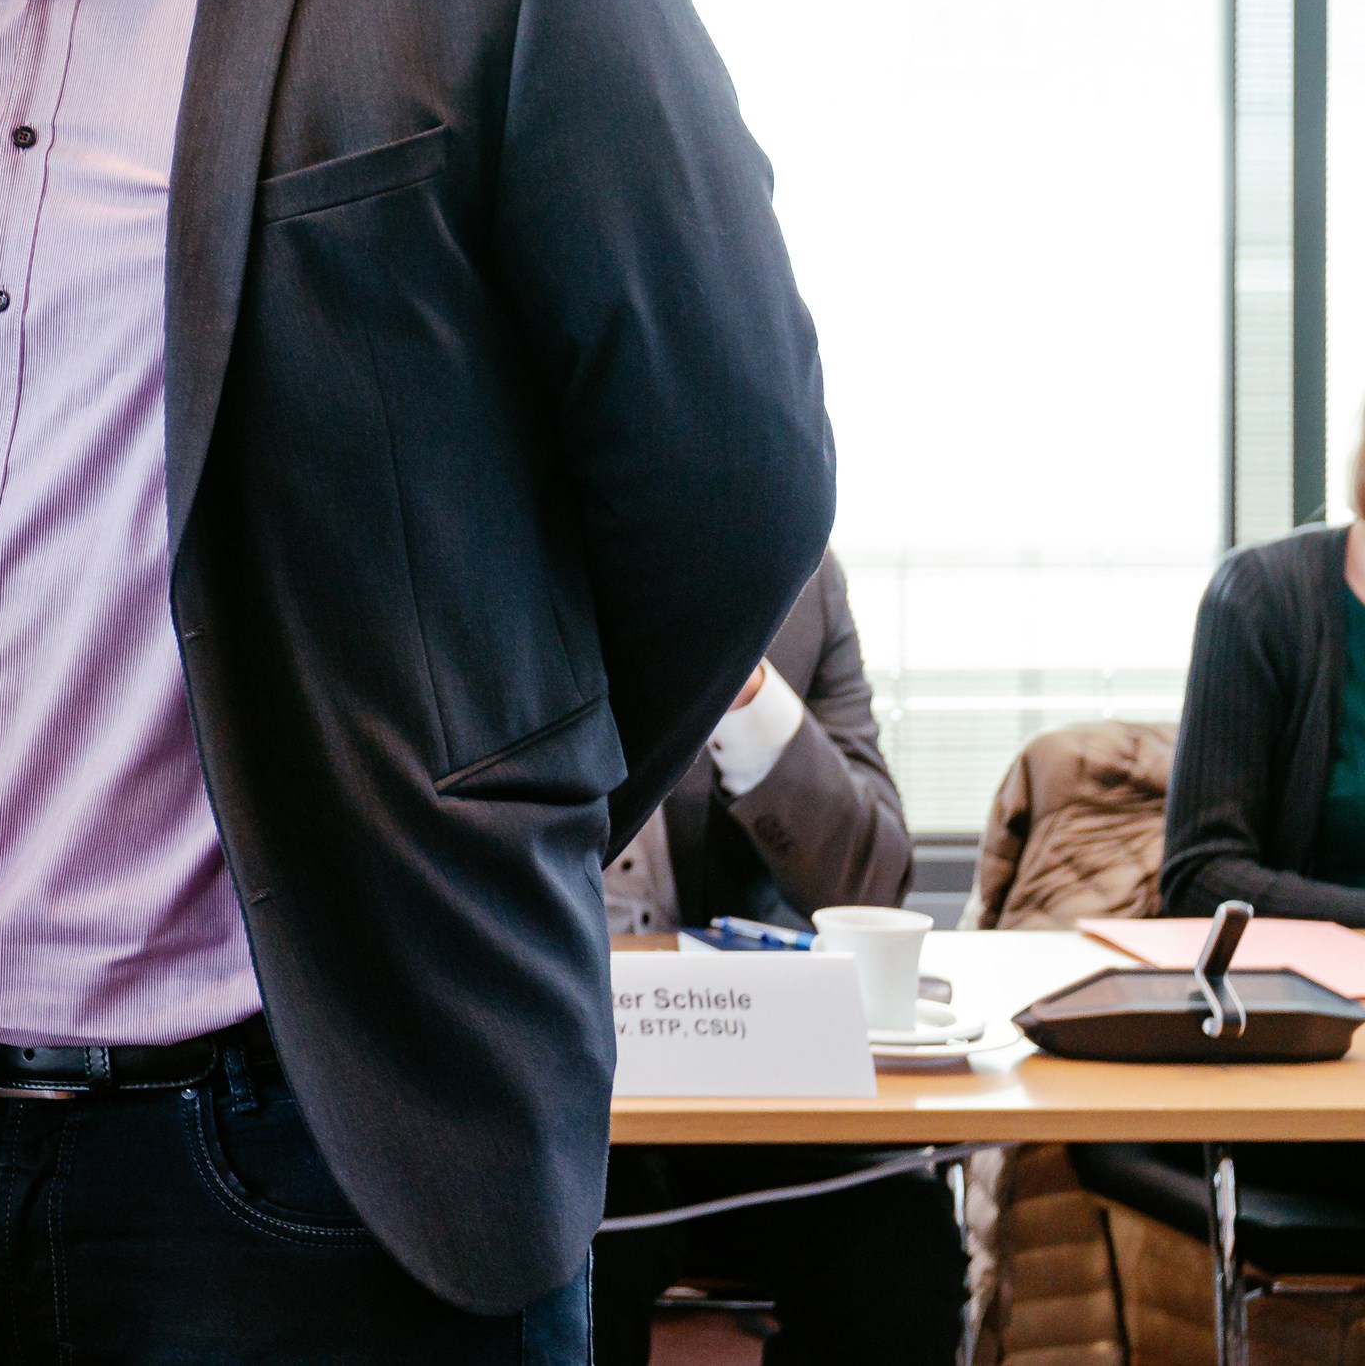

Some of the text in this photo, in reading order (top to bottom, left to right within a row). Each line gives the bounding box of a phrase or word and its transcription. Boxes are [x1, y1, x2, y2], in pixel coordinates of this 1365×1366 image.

[654, 988, 752, 1009] Schiele
[640, 1019, 688, 1038] BTP,
[694, 1018, 747, 1039] CSU)
